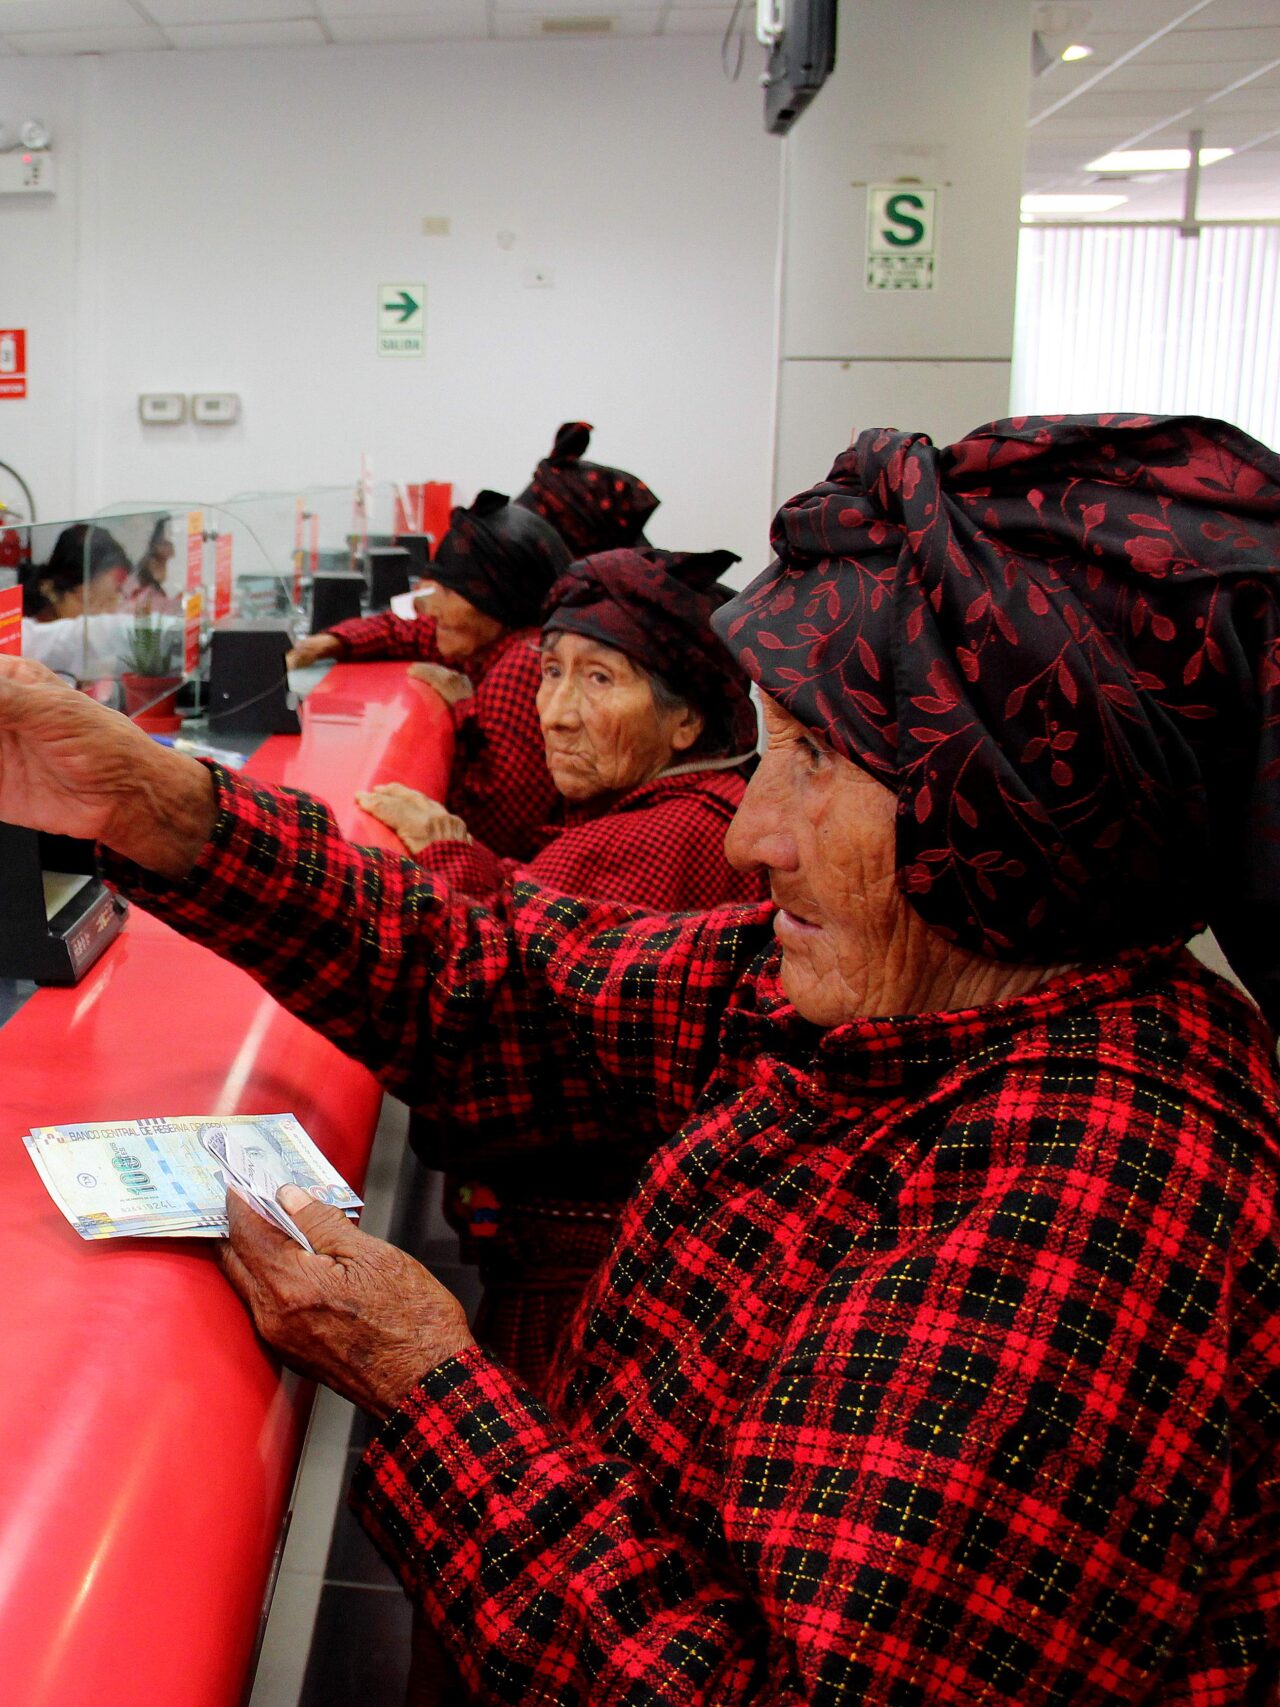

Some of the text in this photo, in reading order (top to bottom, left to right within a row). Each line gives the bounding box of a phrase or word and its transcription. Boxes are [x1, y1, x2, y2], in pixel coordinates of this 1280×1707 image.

[882, 194, 924, 247] S
[69, 1128, 100, 1142] BANCO
[101, 1126, 141, 1139] CENTRAL
[140, 1125, 154, 1136] DE
[154, 1122, 190, 1135] RESERVA
